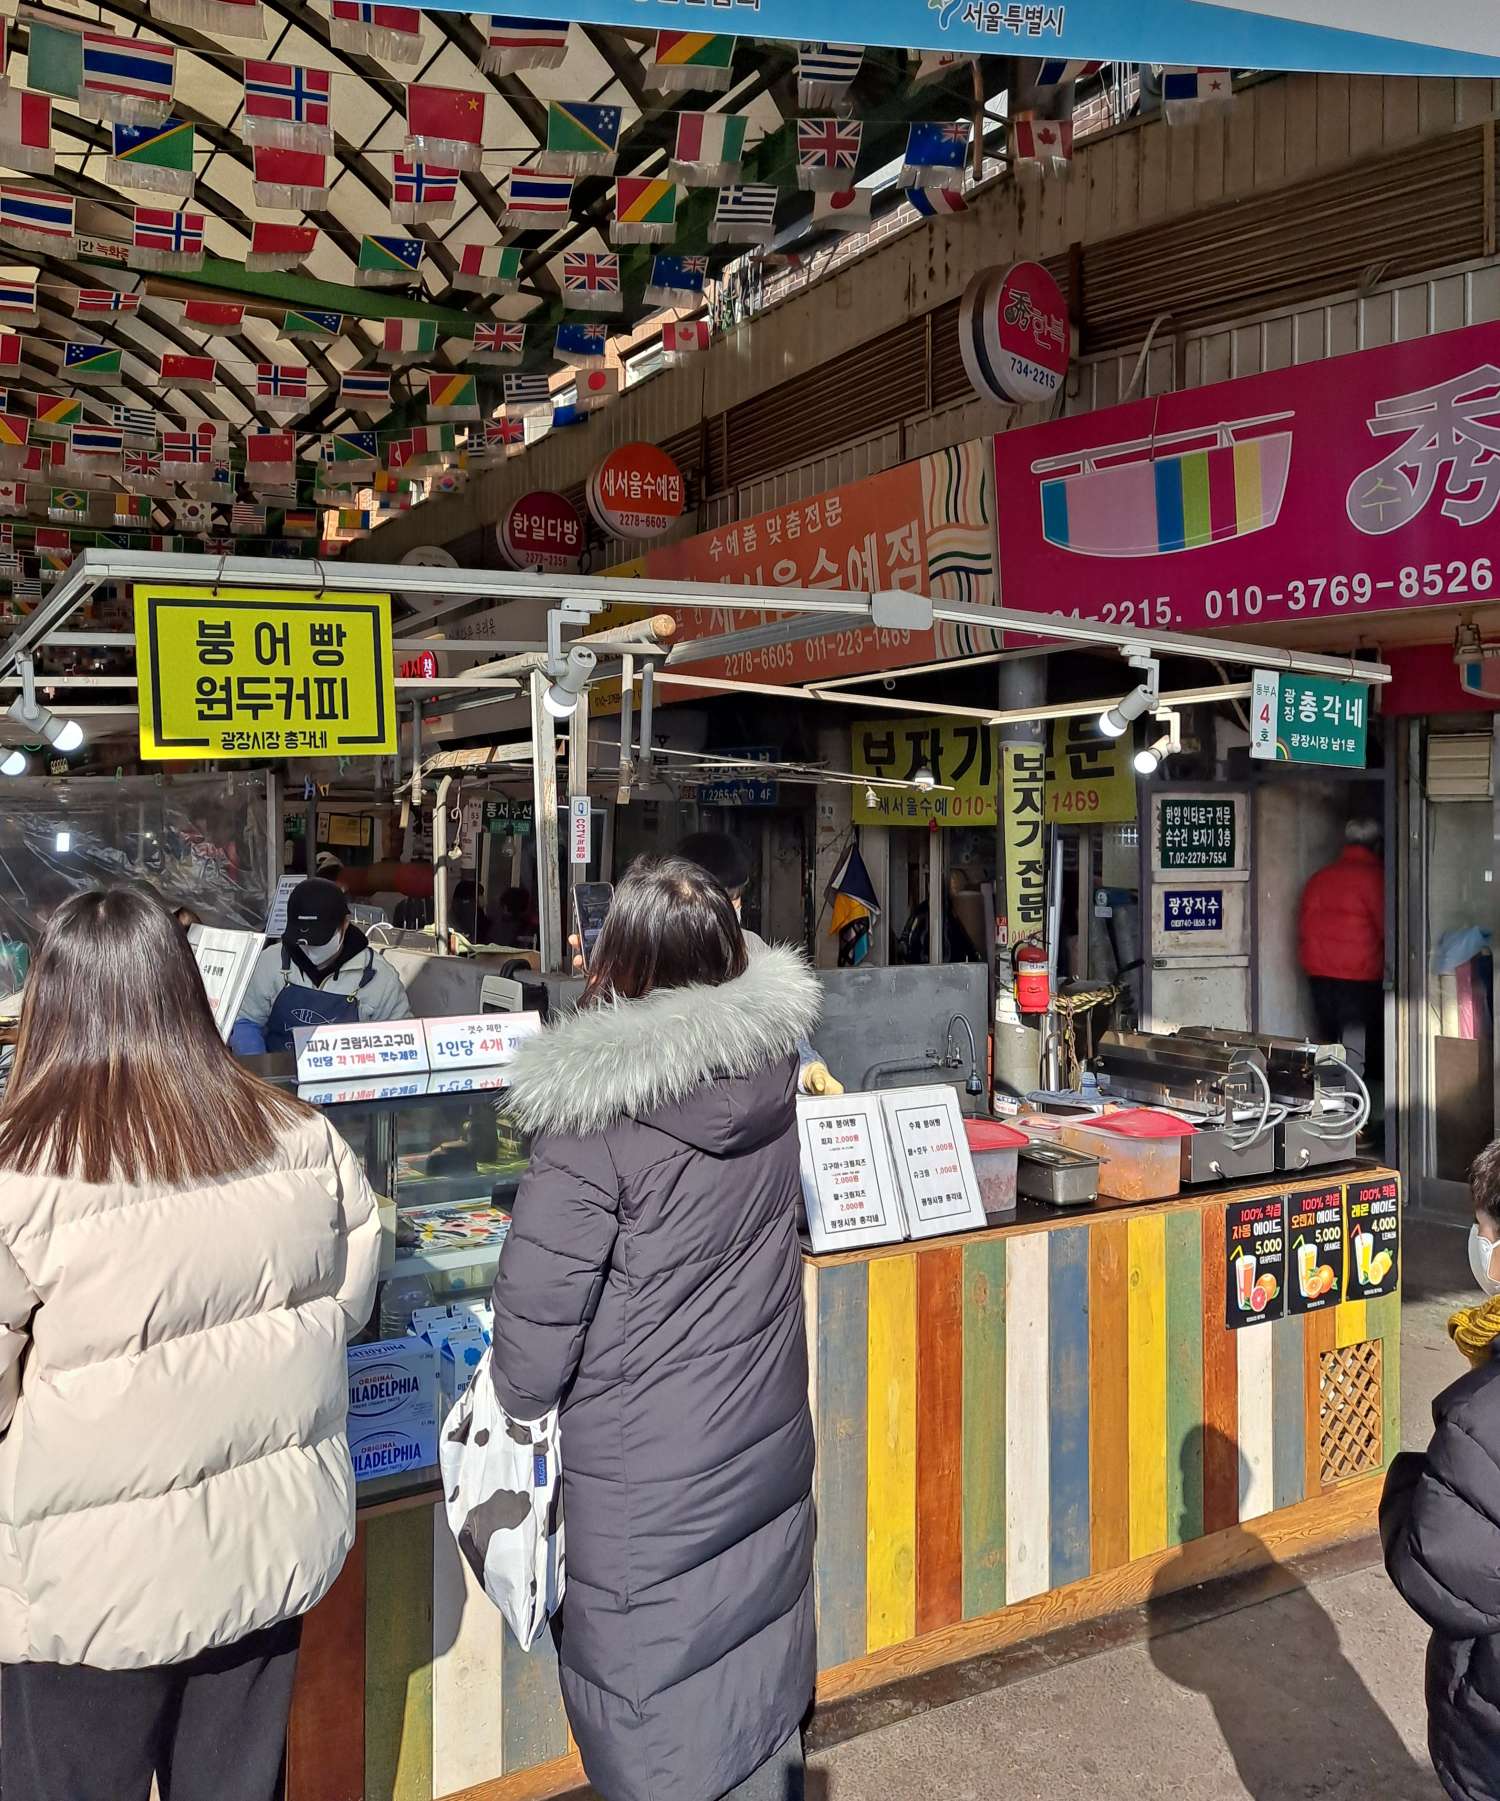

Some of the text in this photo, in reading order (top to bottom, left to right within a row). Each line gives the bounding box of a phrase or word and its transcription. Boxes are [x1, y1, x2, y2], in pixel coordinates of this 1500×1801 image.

[963, 3, 1065, 36] 서울특별시
[1010, 357, 1056, 389] 734-2215
[602, 468, 681, 503] 새서울수예점
[512, 511, 579, 545] 한일다방
[619, 512, 668, 530] 2278-6605
[766, 495, 843, 546] 맞춤전문
[1204, 557, 1494, 620] 010-3769-8526
[724, 630, 911, 677] 2278-6605 011-223-1469
[195, 676, 349, 720] 원두커피
[1283, 688, 1296, 722] 광장
[1259, 703, 1271, 723] 4
[1298, 690, 1363, 728] 총각네
[220, 731, 328, 750] 광장시장 총각네
[1260, 728, 1270, 743] 호
[1290, 733, 1357, 752] 광장시장 남1문
[862, 724, 991, 787] 보자기
[1165, 806, 1181, 825] 한양
[1216, 806, 1231, 825] 전문
[1165, 828, 1231, 847] 손수건 보자기 3층
[1168, 897, 1219, 915] 광장자수
[486, 1023, 502, 1033] 제한
[306, 1037, 329, 1052] 피자
[340, 1033, 415, 1050] 크림치즈고구마
[437, 1040, 474, 1056] 1인당
[480, 1037, 503, 1052] 4개
[306, 1055, 334, 1068] 1인당
[836, 1118, 856, 1128] 붕어빵
[821, 1137, 833, 1145] 피자
[1302, 1197, 1324, 1211] 100%
[1359, 1187, 1381, 1202] 100%
[1240, 1208, 1264, 1222] 100%
[1351, 1199, 1397, 1218] 레몬 에이드
[1291, 1208, 1341, 1229] 오렌지 에이드
[1371, 1216, 1397, 1232] 4,000
[1232, 1218, 1282, 1240] 자몽 에이드
[1315, 1226, 1341, 1243] 5,000
[1255, 1238, 1283, 1255] 5,000
[358, 1373, 394, 1386] ORIGINAL
[361, 1441, 396, 1454] ORIGINAL
